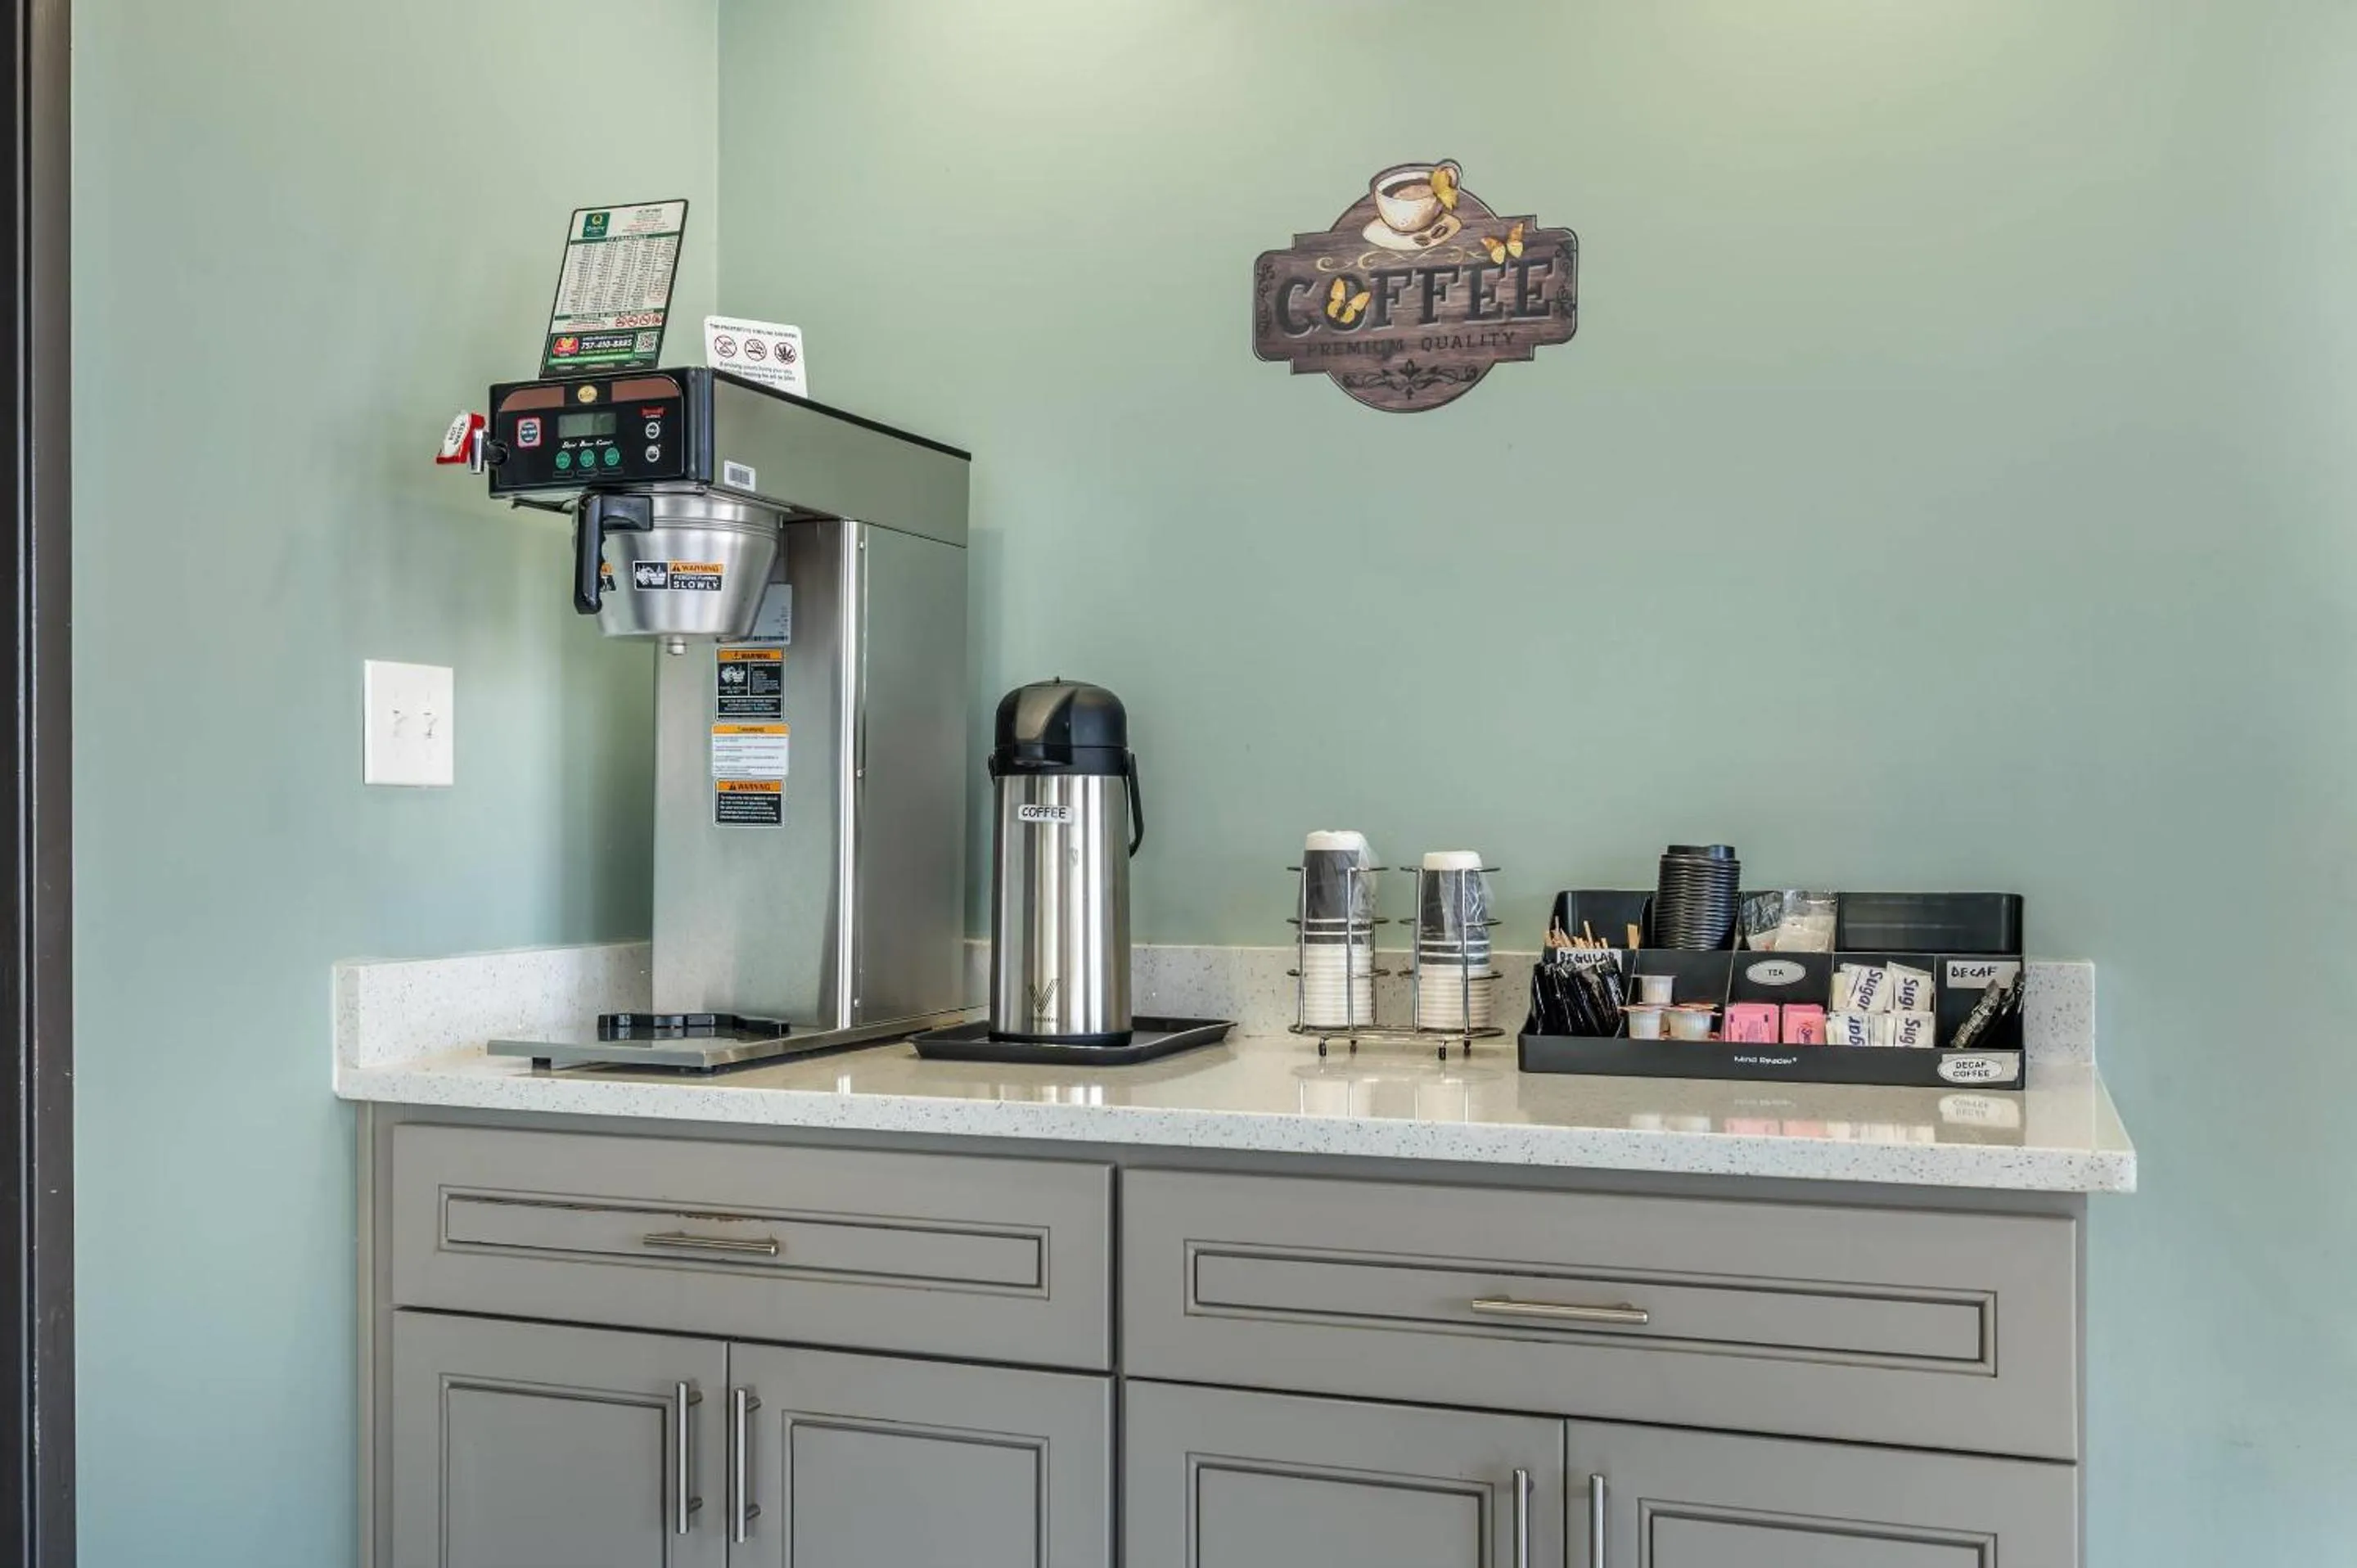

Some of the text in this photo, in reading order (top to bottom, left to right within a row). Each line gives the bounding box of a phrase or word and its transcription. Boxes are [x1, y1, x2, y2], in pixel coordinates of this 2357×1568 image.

[1274, 257, 1557, 338] COFFEE
[1308, 331, 1517, 358] PREMIUM QUALITY
[674, 580, 720, 589] SLOWLY
[1022, 806, 1066, 819] COFFEE
[1951, 966, 1999, 977] DECAF
[1857, 968, 1884, 1011] Sugar
[1898, 978, 1919, 1011] Sug
[1849, 1016, 1866, 1046] gar
[1899, 1017, 1922, 1047] Sug
[1953, 1070, 1990, 1078] COFFEE
[1955, 1061, 1986, 1070] DECAF
